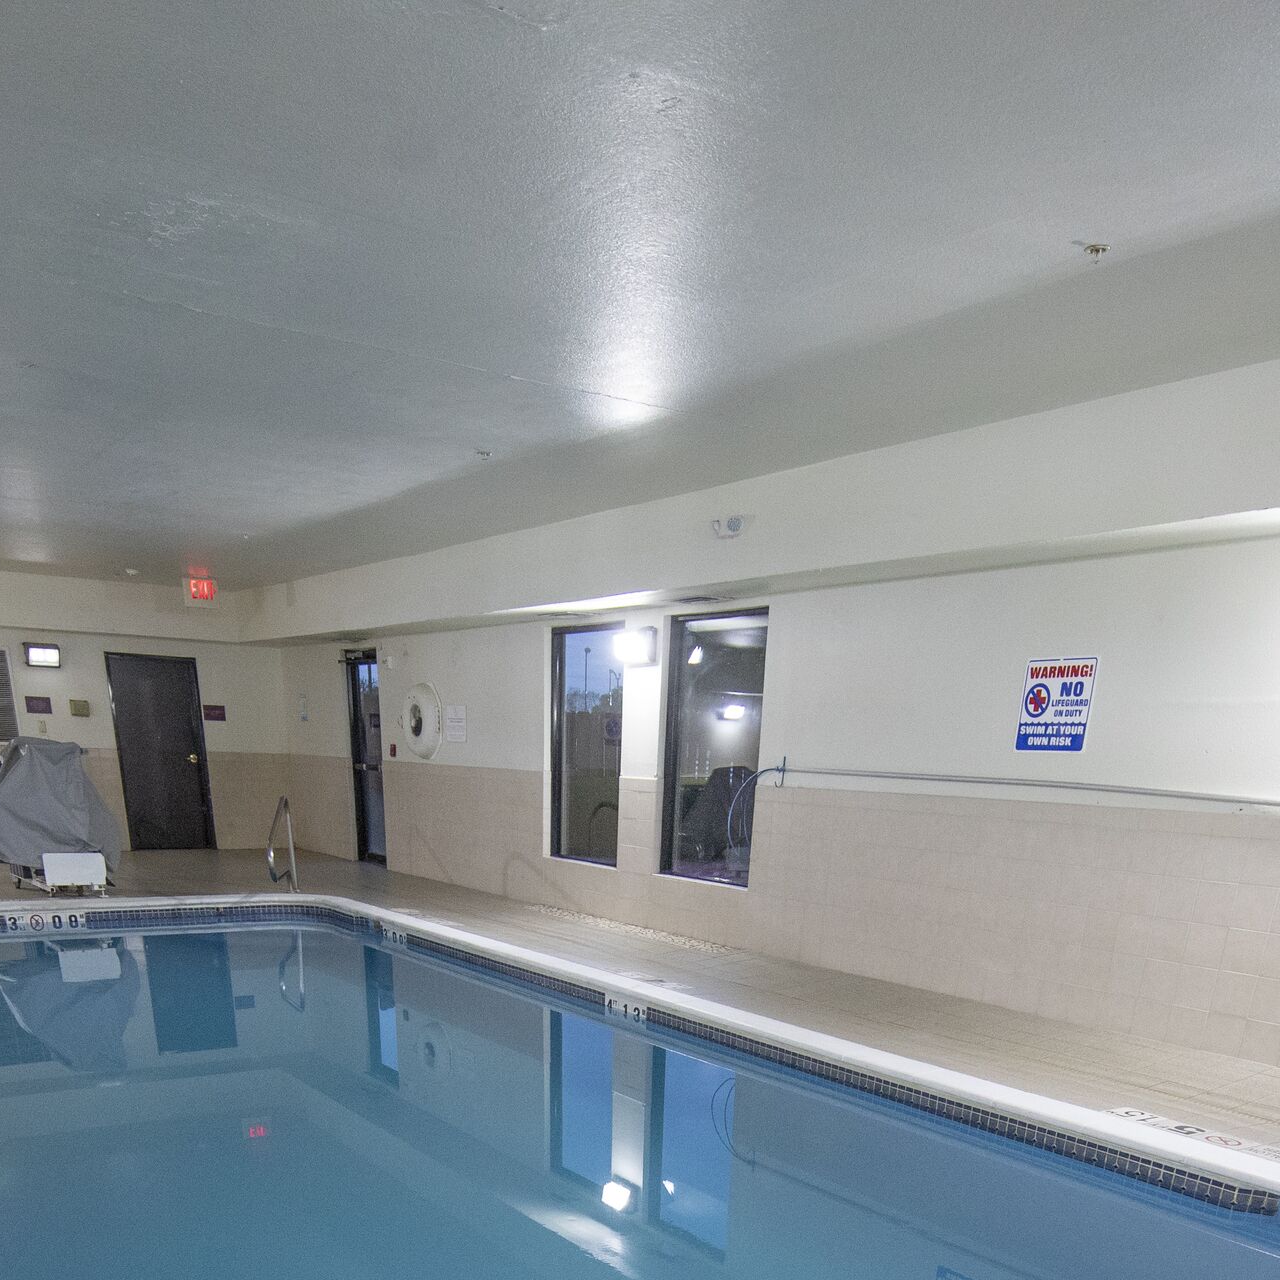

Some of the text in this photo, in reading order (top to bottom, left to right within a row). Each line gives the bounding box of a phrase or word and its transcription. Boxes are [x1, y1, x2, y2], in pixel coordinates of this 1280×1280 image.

[190, 579, 214, 600] EXIT
[1030, 664, 1094, 679] WARNING!
[1060, 681, 1084, 698] NO
[1051, 698, 1089, 708] LIFEGUARD
[1053, 709, 1083, 718] ON DUTY
[1020, 725, 1084, 735] SWIM AT YOUR
[1027, 736, 1072, 746] OWN RISK
